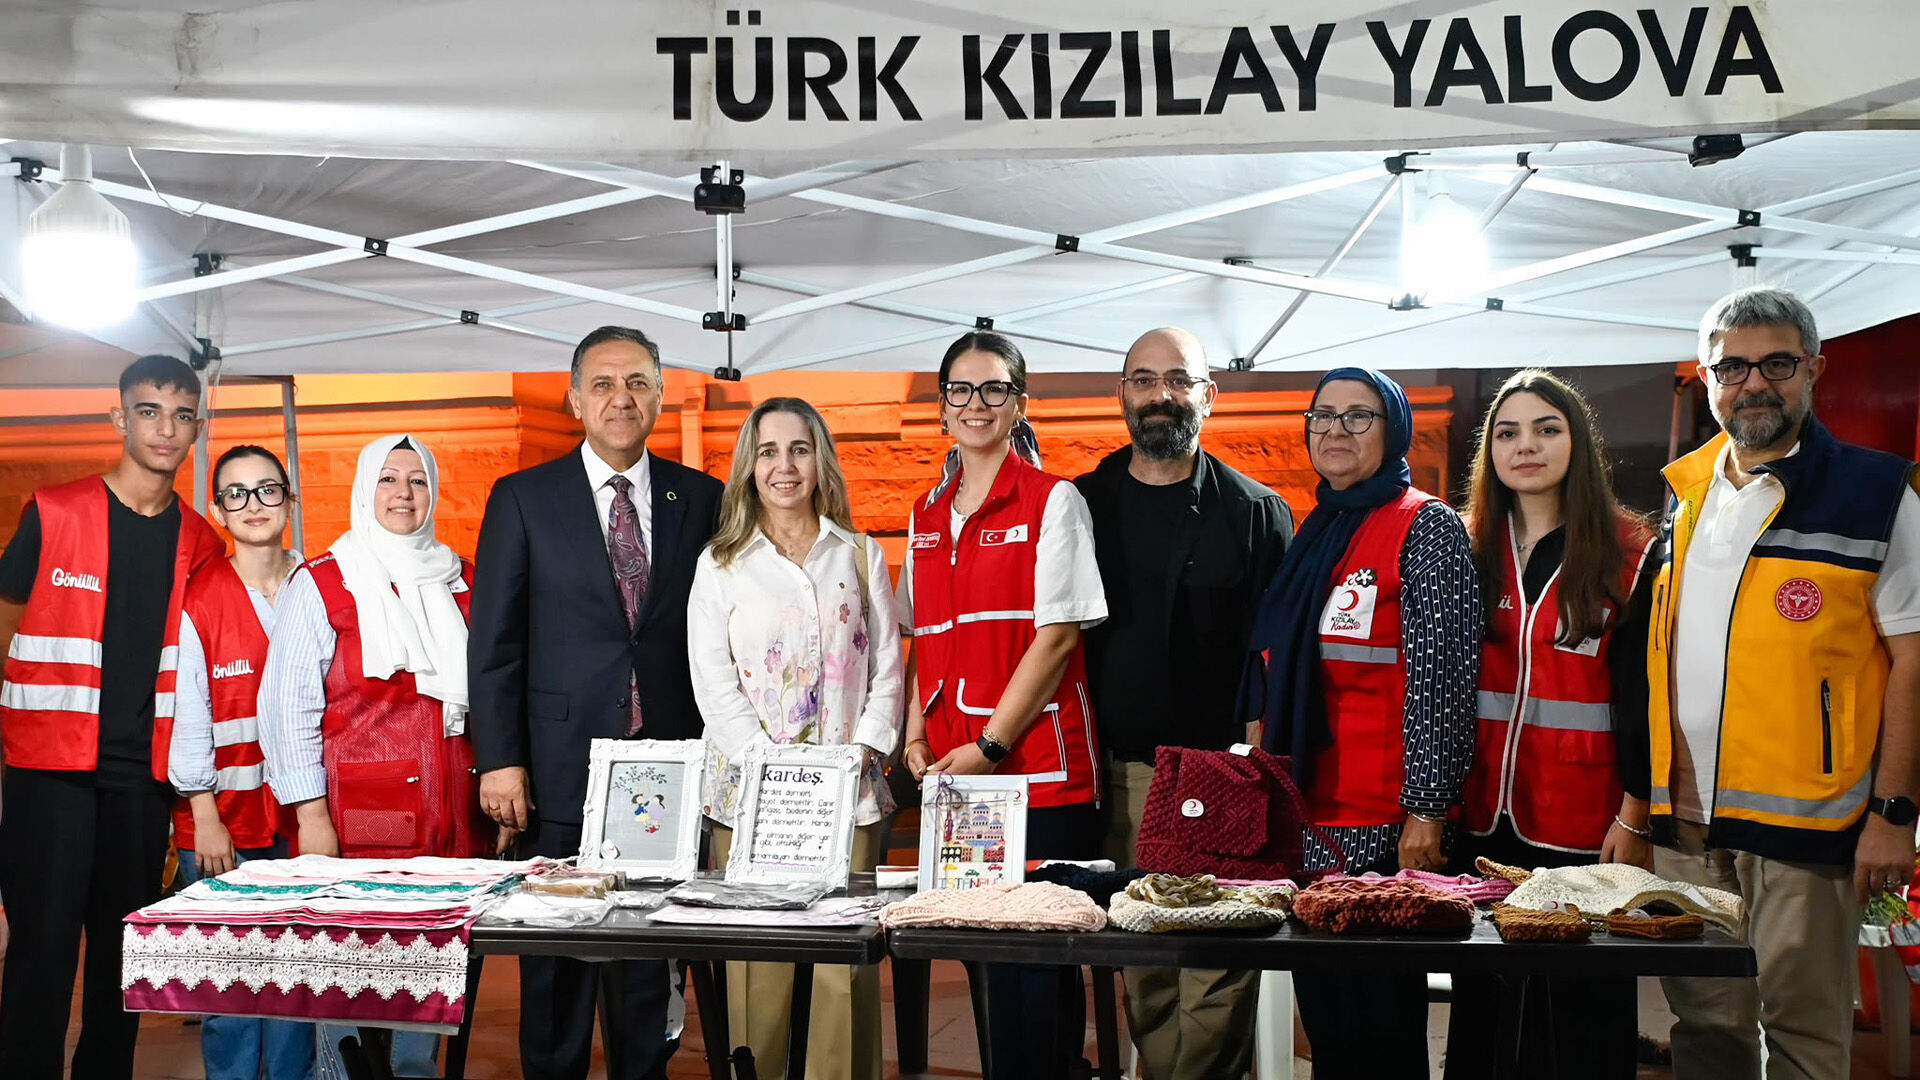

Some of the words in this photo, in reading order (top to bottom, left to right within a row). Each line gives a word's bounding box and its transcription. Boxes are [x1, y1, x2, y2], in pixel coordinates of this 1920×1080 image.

[656, 10, 923, 122] TÜRK
[962, 23, 1336, 120] KIZILAY
[1365, 6, 1784, 108] YALOVA
[52, 567, 102, 592] Gönüllü
[212, 659, 254, 679] önüllü
